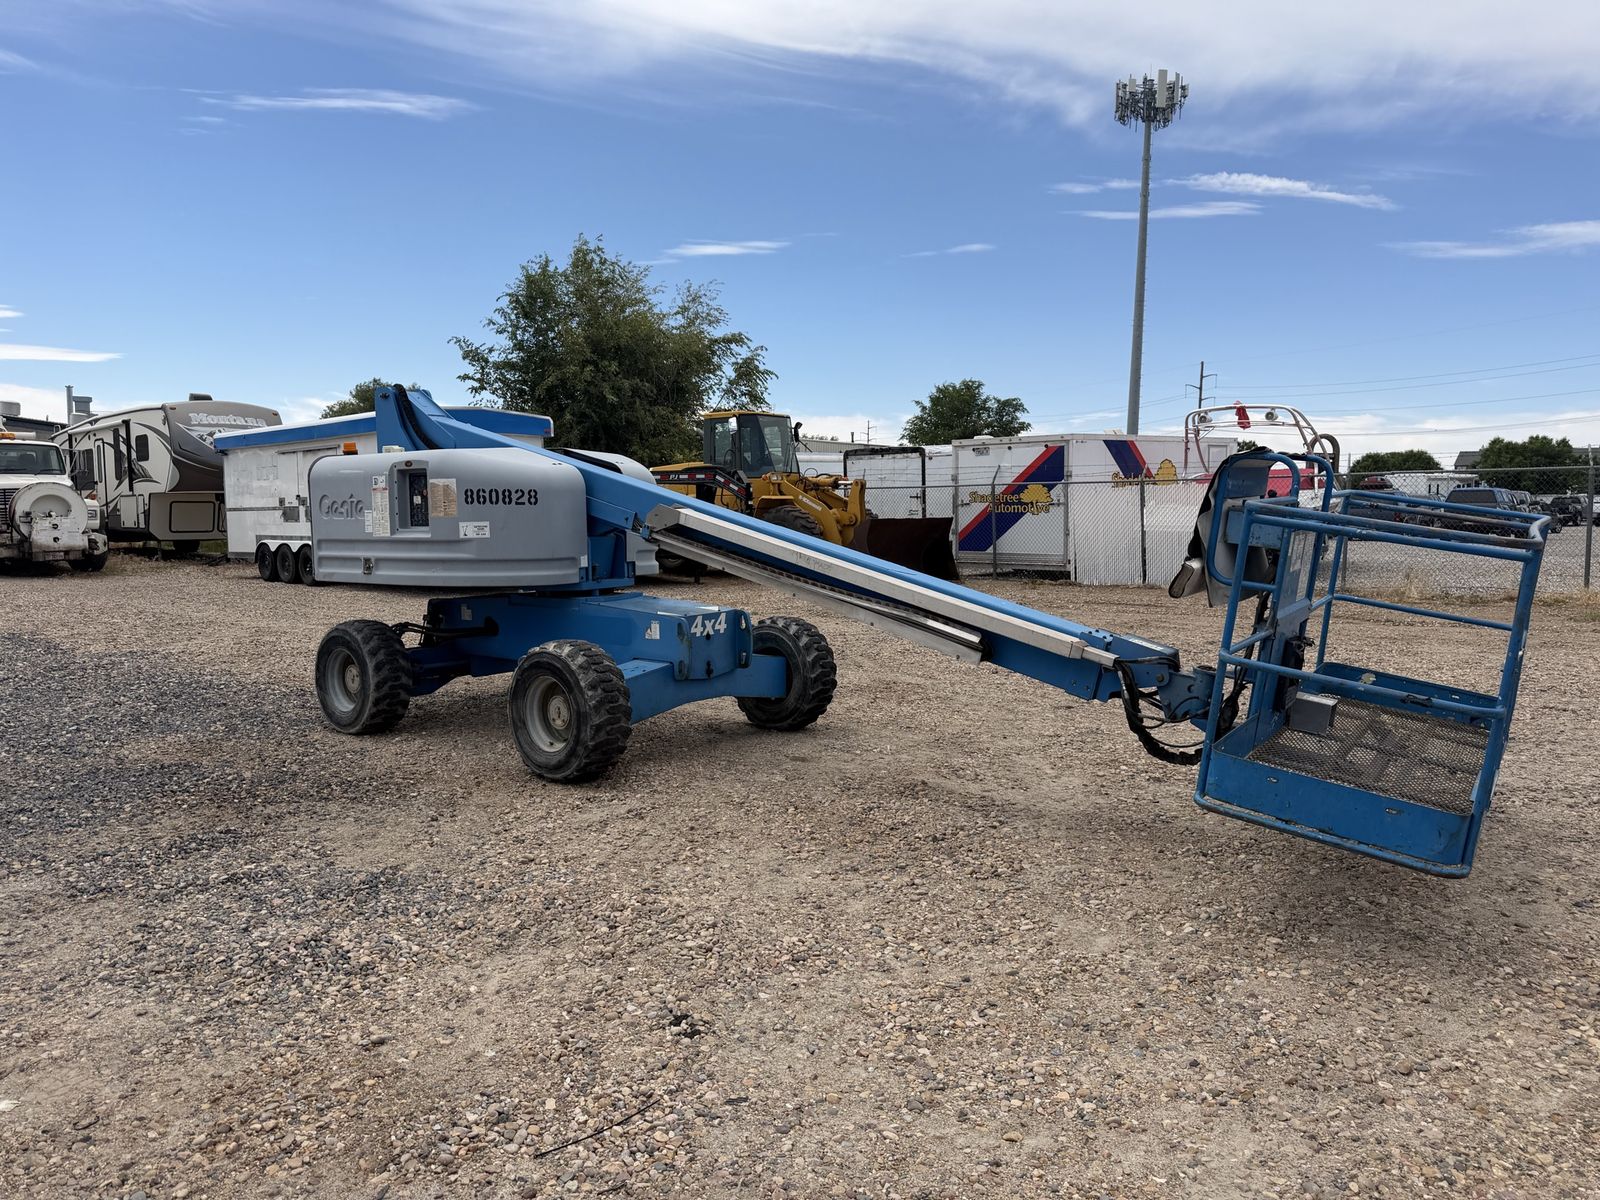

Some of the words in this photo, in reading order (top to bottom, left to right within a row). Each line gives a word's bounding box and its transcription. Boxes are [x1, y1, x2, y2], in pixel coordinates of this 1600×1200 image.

[188, 413, 267, 427] Montana
[319, 493, 365, 520] Genie
[464, 488, 538, 505] 860828
[690, 612, 727, 637] 4x4
